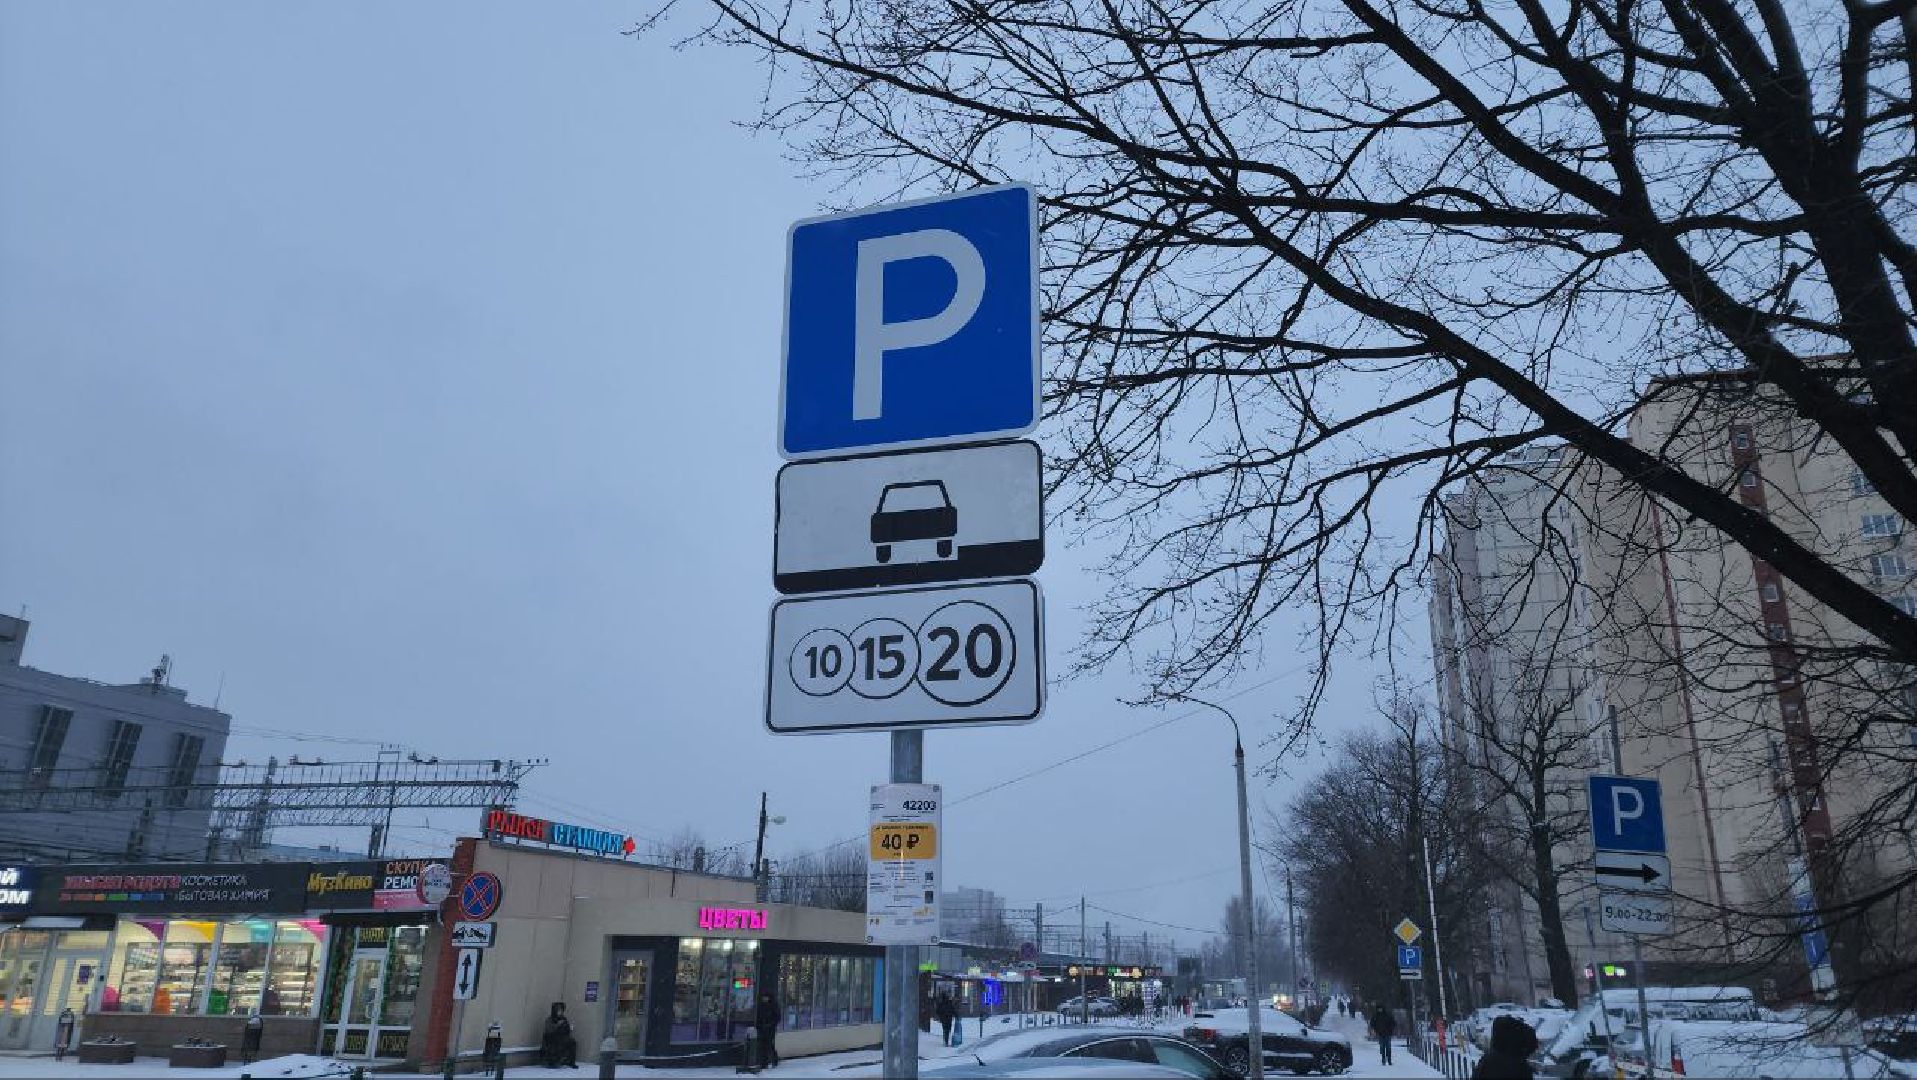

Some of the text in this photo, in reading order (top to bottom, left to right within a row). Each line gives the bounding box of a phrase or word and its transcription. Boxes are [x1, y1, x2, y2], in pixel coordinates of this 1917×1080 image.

[853, 229, 986, 420] P
[804, 623, 1002, 682] 10 15 20
[903, 800, 937, 811] 42203
[1611, 786, 1645, 836] P
[553, 824, 624, 855] СТАНЦИЯ
[882, 834, 902, 850] 40
[386, 860, 430, 875] СКУПК
[699, 907, 768, 931] ЦВЕТЫ
[1405, 948, 1416, 965] P
